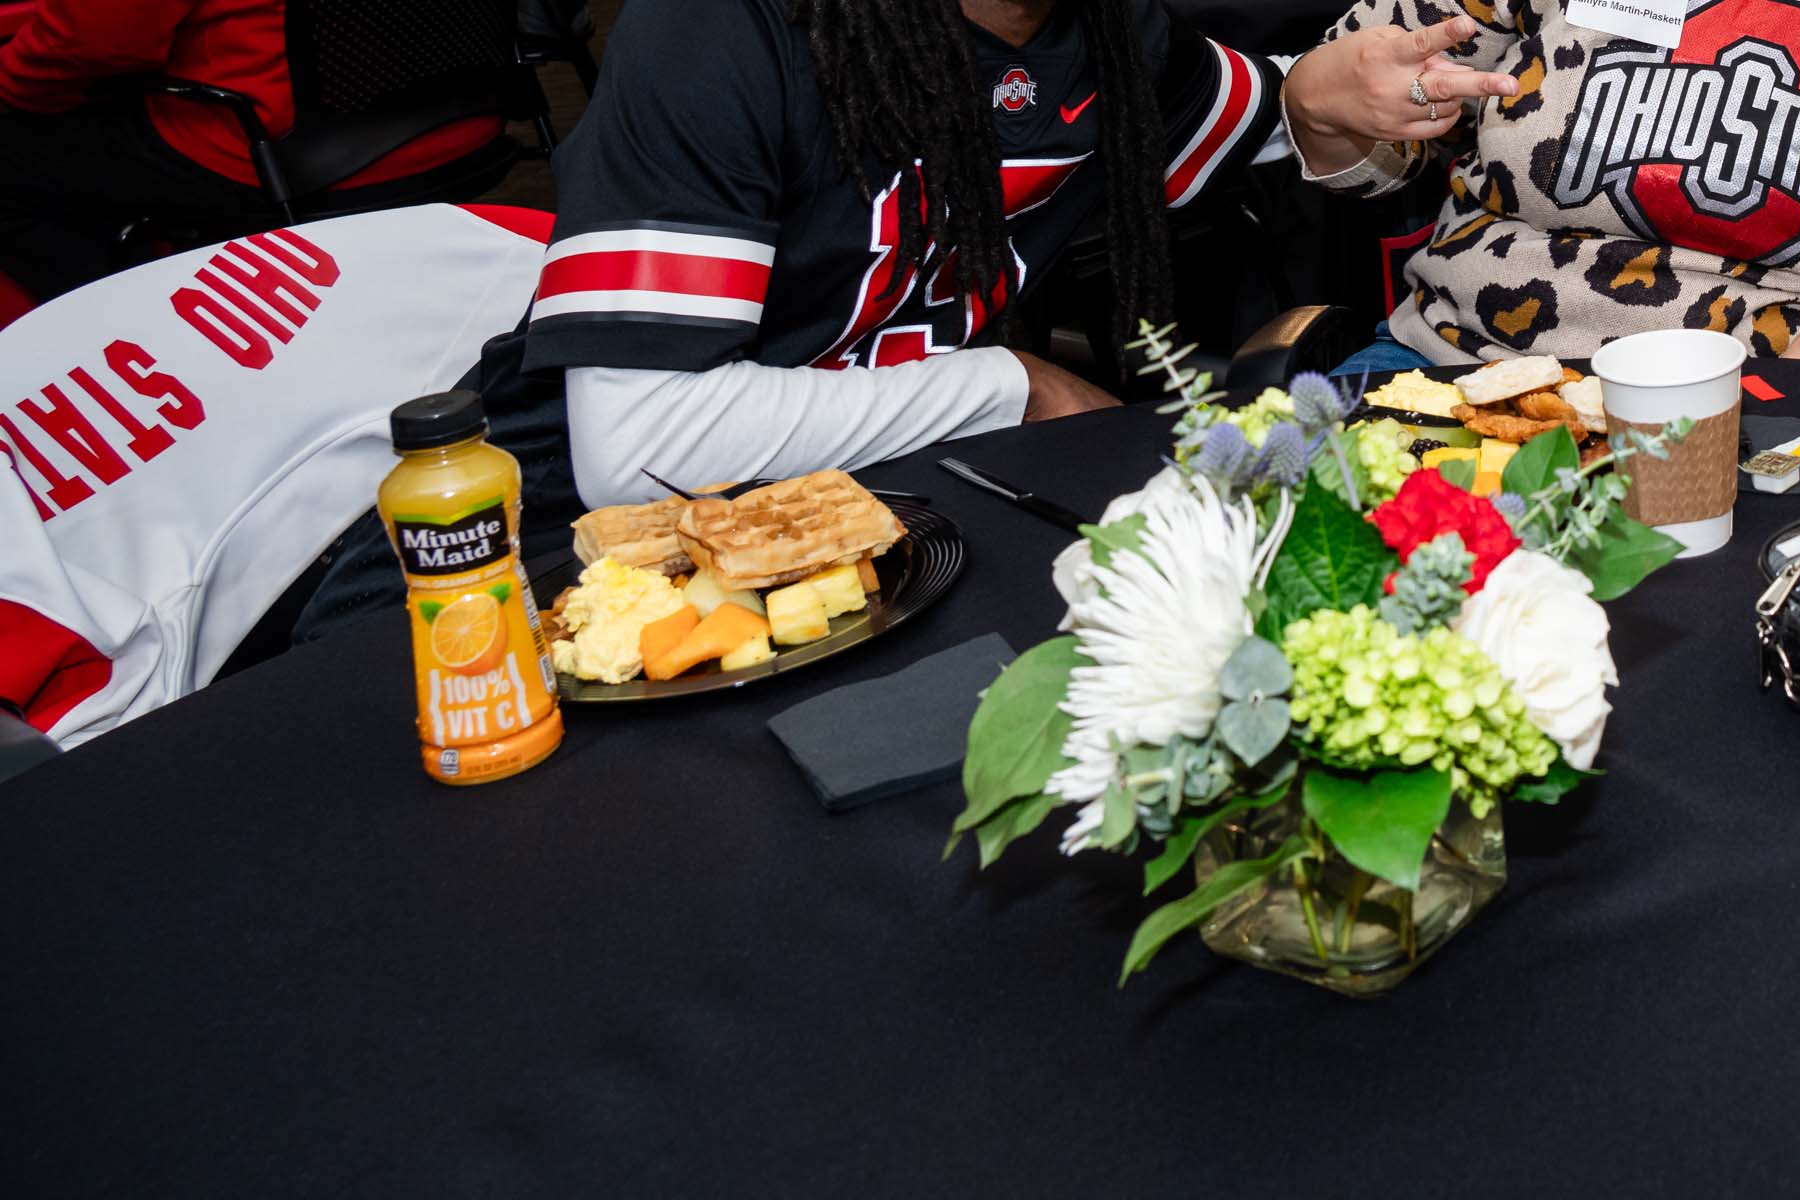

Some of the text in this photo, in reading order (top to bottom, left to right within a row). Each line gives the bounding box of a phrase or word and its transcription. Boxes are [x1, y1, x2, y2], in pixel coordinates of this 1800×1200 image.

[1610, 0, 1682, 26] Martin-Plaskett
[0, 229, 341, 523] OHIO STAT
[403, 519, 502, 550] Minute
[418, 538, 493, 568] Maid
[445, 666, 510, 703] 100%
[447, 701, 516, 739] VIT C
